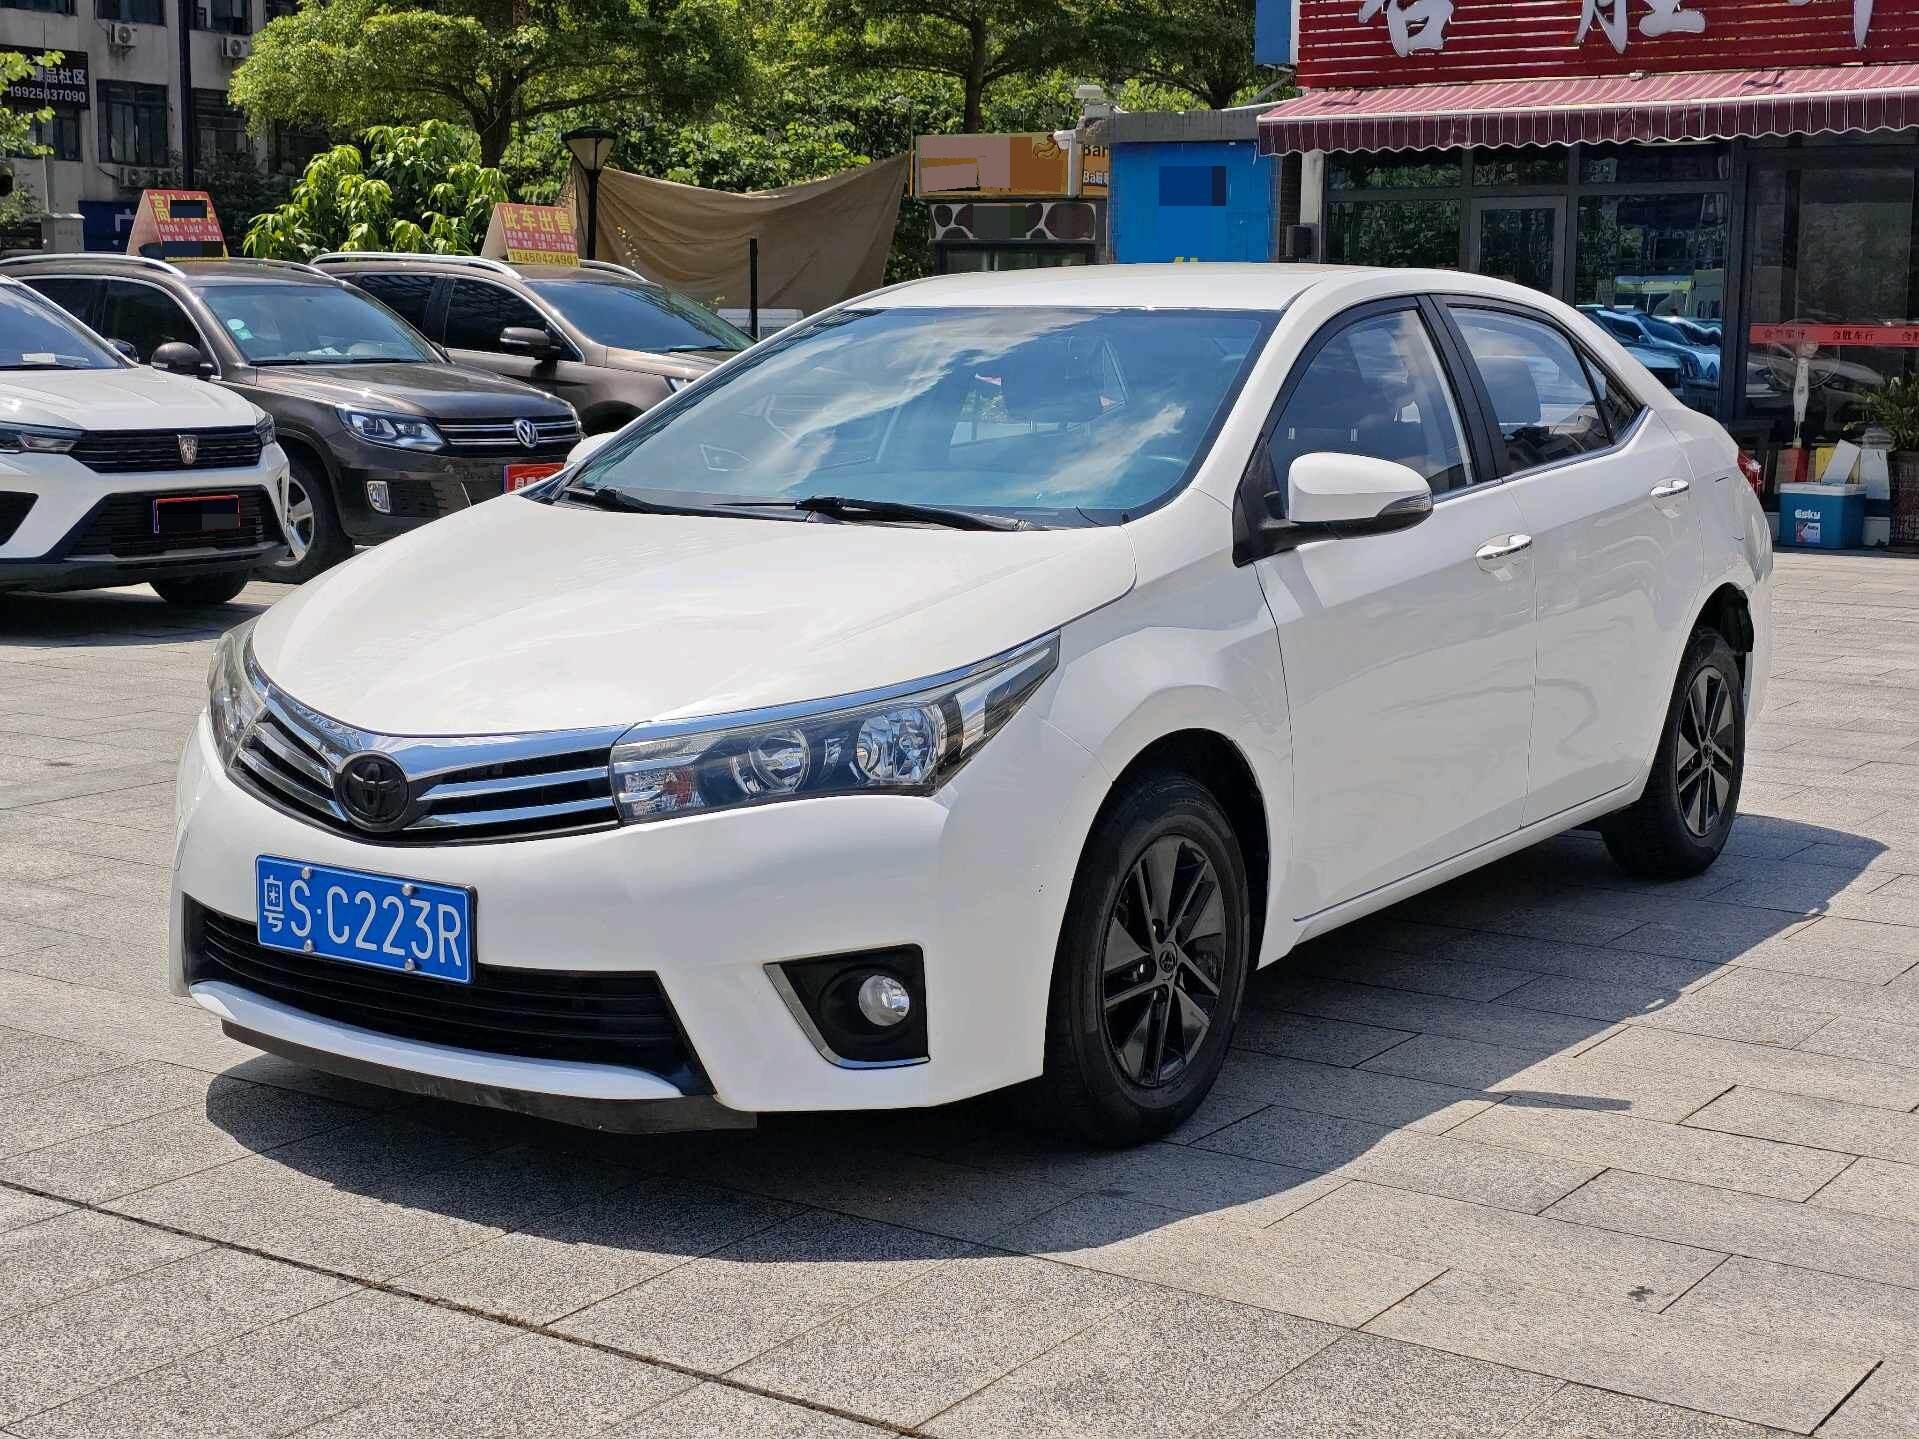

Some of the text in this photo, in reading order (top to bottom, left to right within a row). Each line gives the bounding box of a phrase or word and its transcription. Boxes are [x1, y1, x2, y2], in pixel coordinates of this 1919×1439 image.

[502, 206, 572, 233] 此车出售
[1795, 509, 1821, 520] Esky
